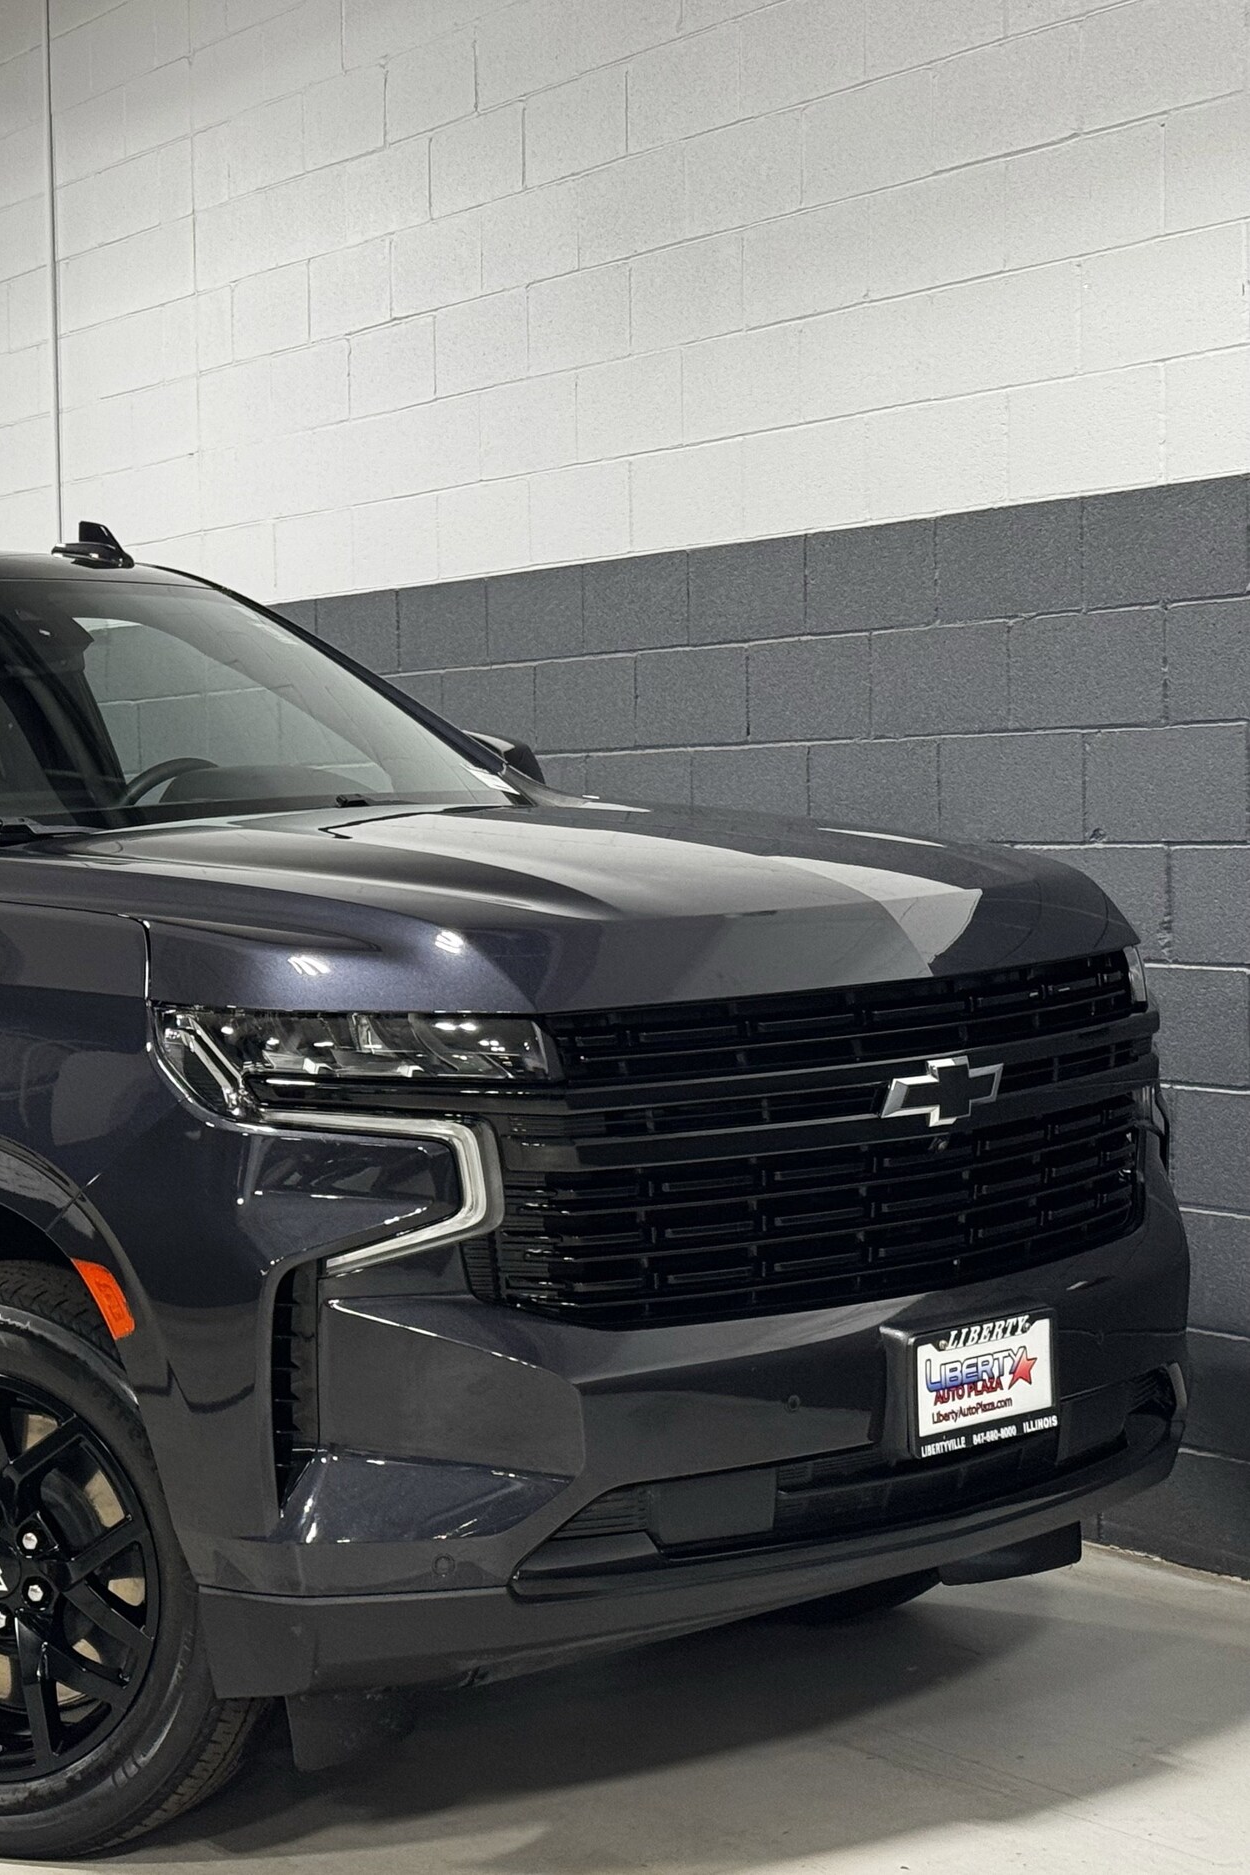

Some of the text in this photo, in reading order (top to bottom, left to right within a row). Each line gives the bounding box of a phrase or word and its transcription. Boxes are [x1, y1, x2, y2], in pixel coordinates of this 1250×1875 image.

[947, 1315, 1030, 1349] LIBERTY
[925, 1345, 1027, 1393] LIBERTY
[934, 1377, 1004, 1406] AUTO PLAZA
[931, 1397, 1013, 1424] LibertyAutoPlaza.com
[921, 1436, 966, 1458] LIBERTYVILLE
[1022, 1415, 1058, 1434] ILLINOIS
